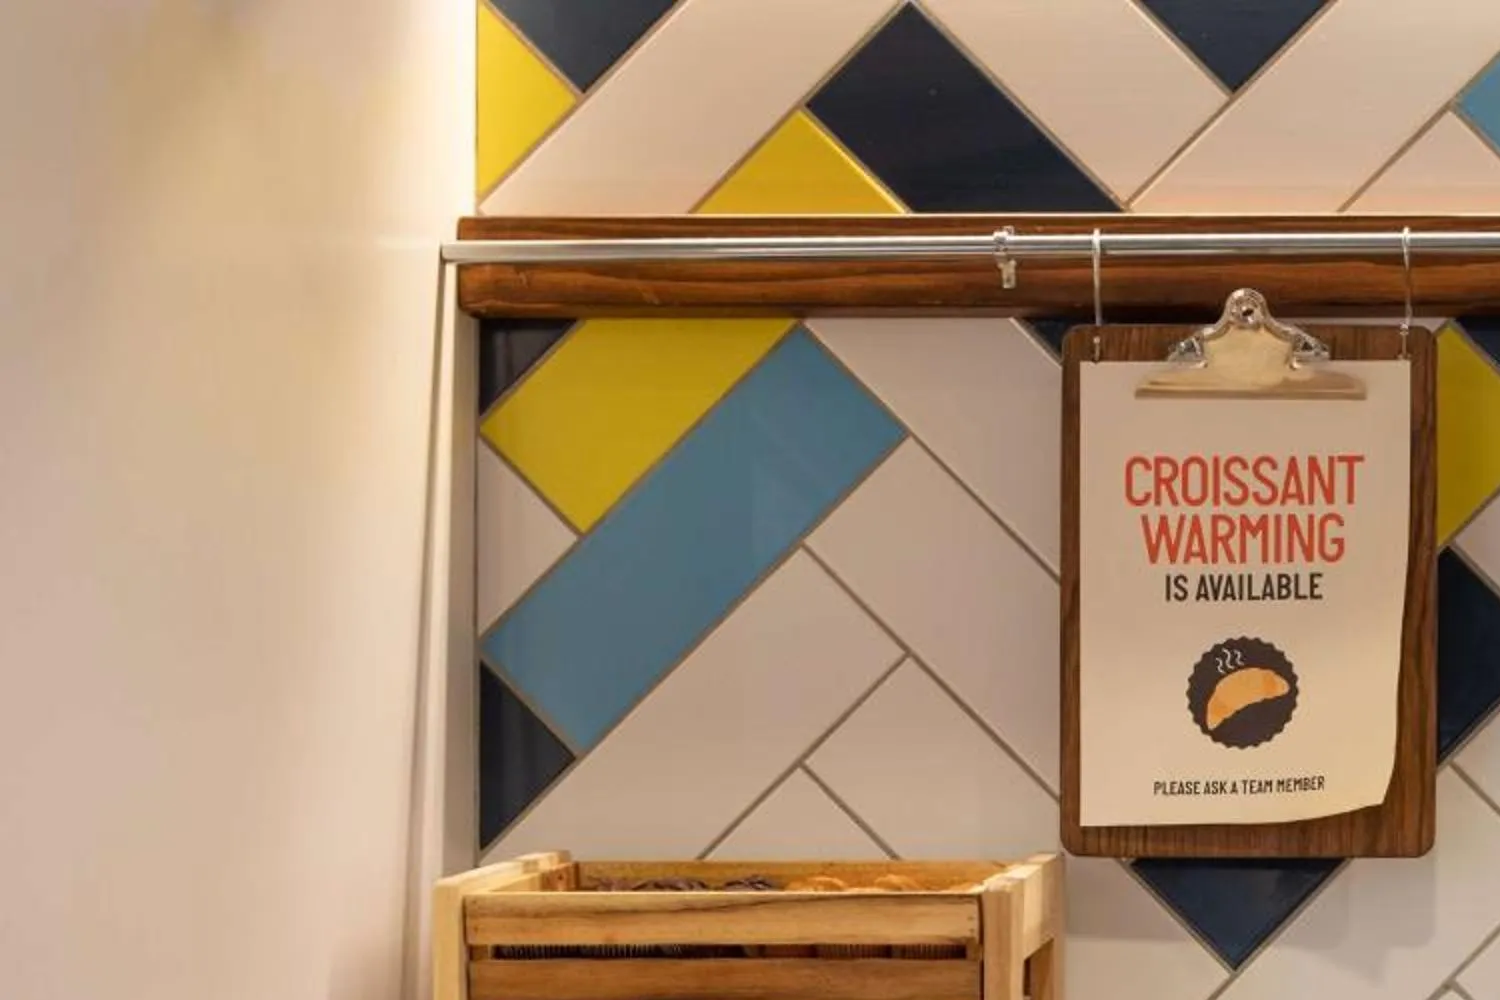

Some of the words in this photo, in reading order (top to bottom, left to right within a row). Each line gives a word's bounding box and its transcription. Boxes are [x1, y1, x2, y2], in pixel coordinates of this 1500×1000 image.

[1124, 456, 1365, 507] CROISSANT
[1141, 512, 1346, 565] WARMING
[1165, 573, 1189, 602] IS
[1195, 572, 1324, 602] AVAILABLE
[1153, 781, 1200, 796] PLEASE
[1203, 781, 1228, 795] ASK
[1229, 780, 1239, 795] A
[1242, 778, 1273, 795] TEAM
[1276, 775, 1325, 793] MEMBER
